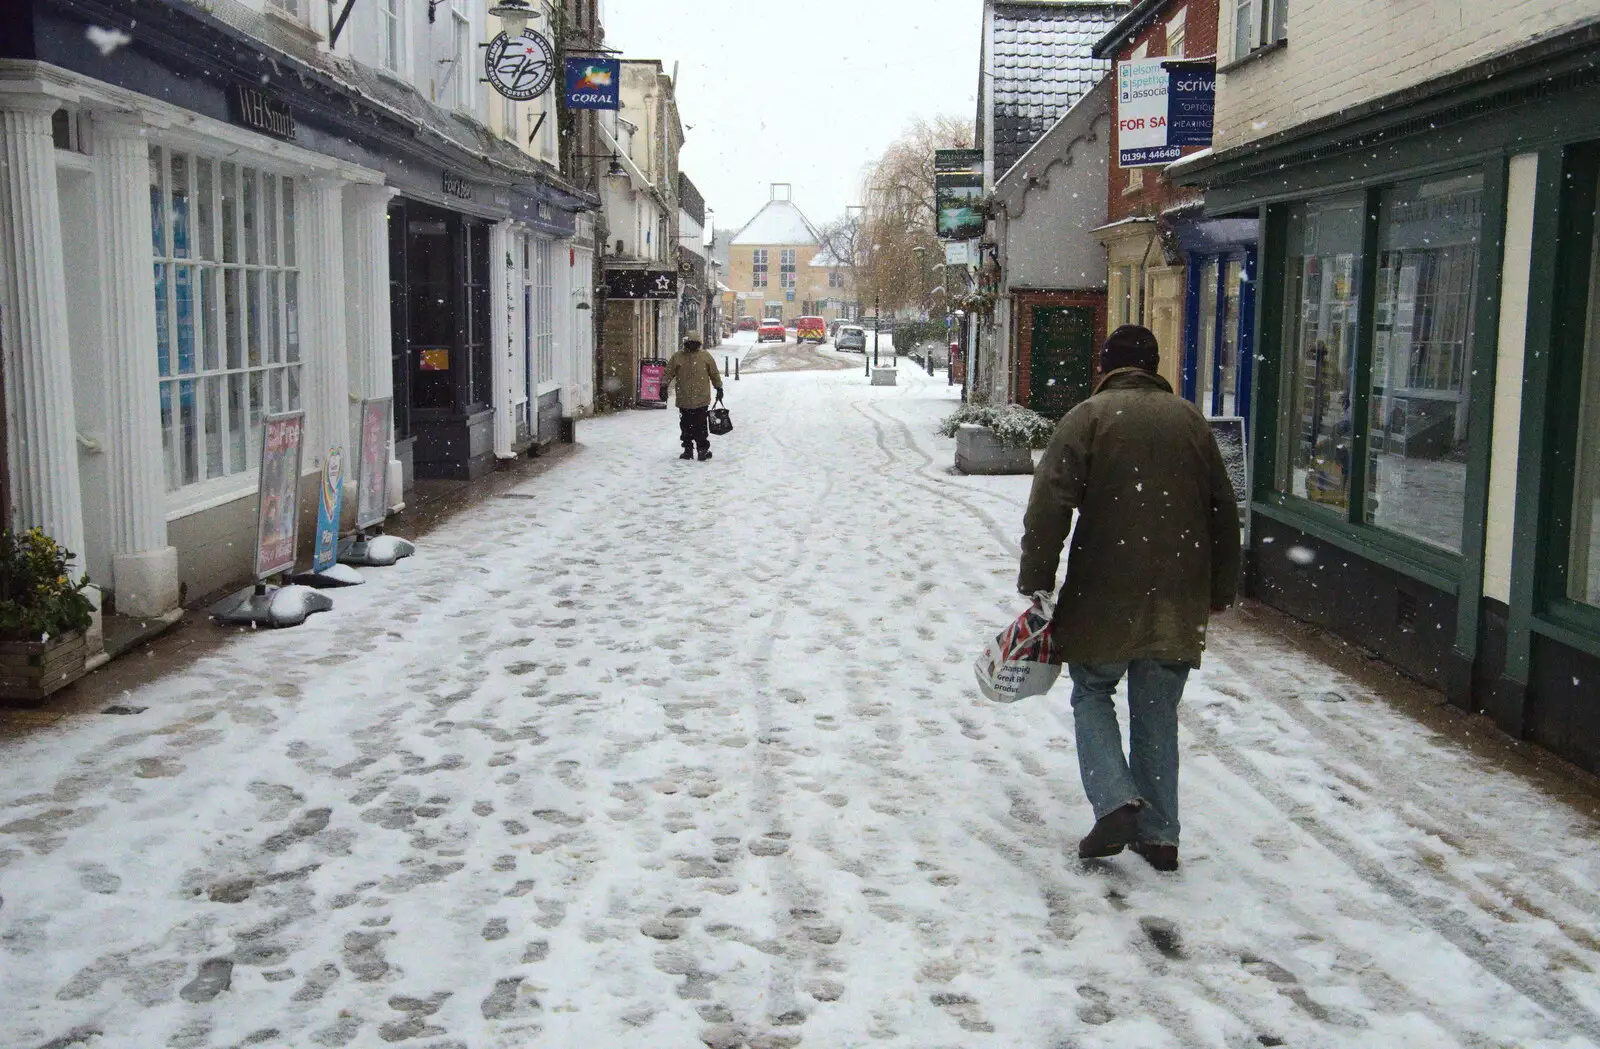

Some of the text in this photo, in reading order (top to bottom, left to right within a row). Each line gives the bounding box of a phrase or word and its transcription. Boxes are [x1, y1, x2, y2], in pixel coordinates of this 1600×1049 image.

[1132, 64, 1160, 75] elsom
[1176, 77, 1216, 92] scrive
[502, 88, 531, 97] COFFEE
[571, 93, 613, 104] CORAL
[1120, 119, 1145, 131] FOR
[1174, 119, 1212, 128] HEARING
[1122, 149, 1181, 162] 01394 446480
